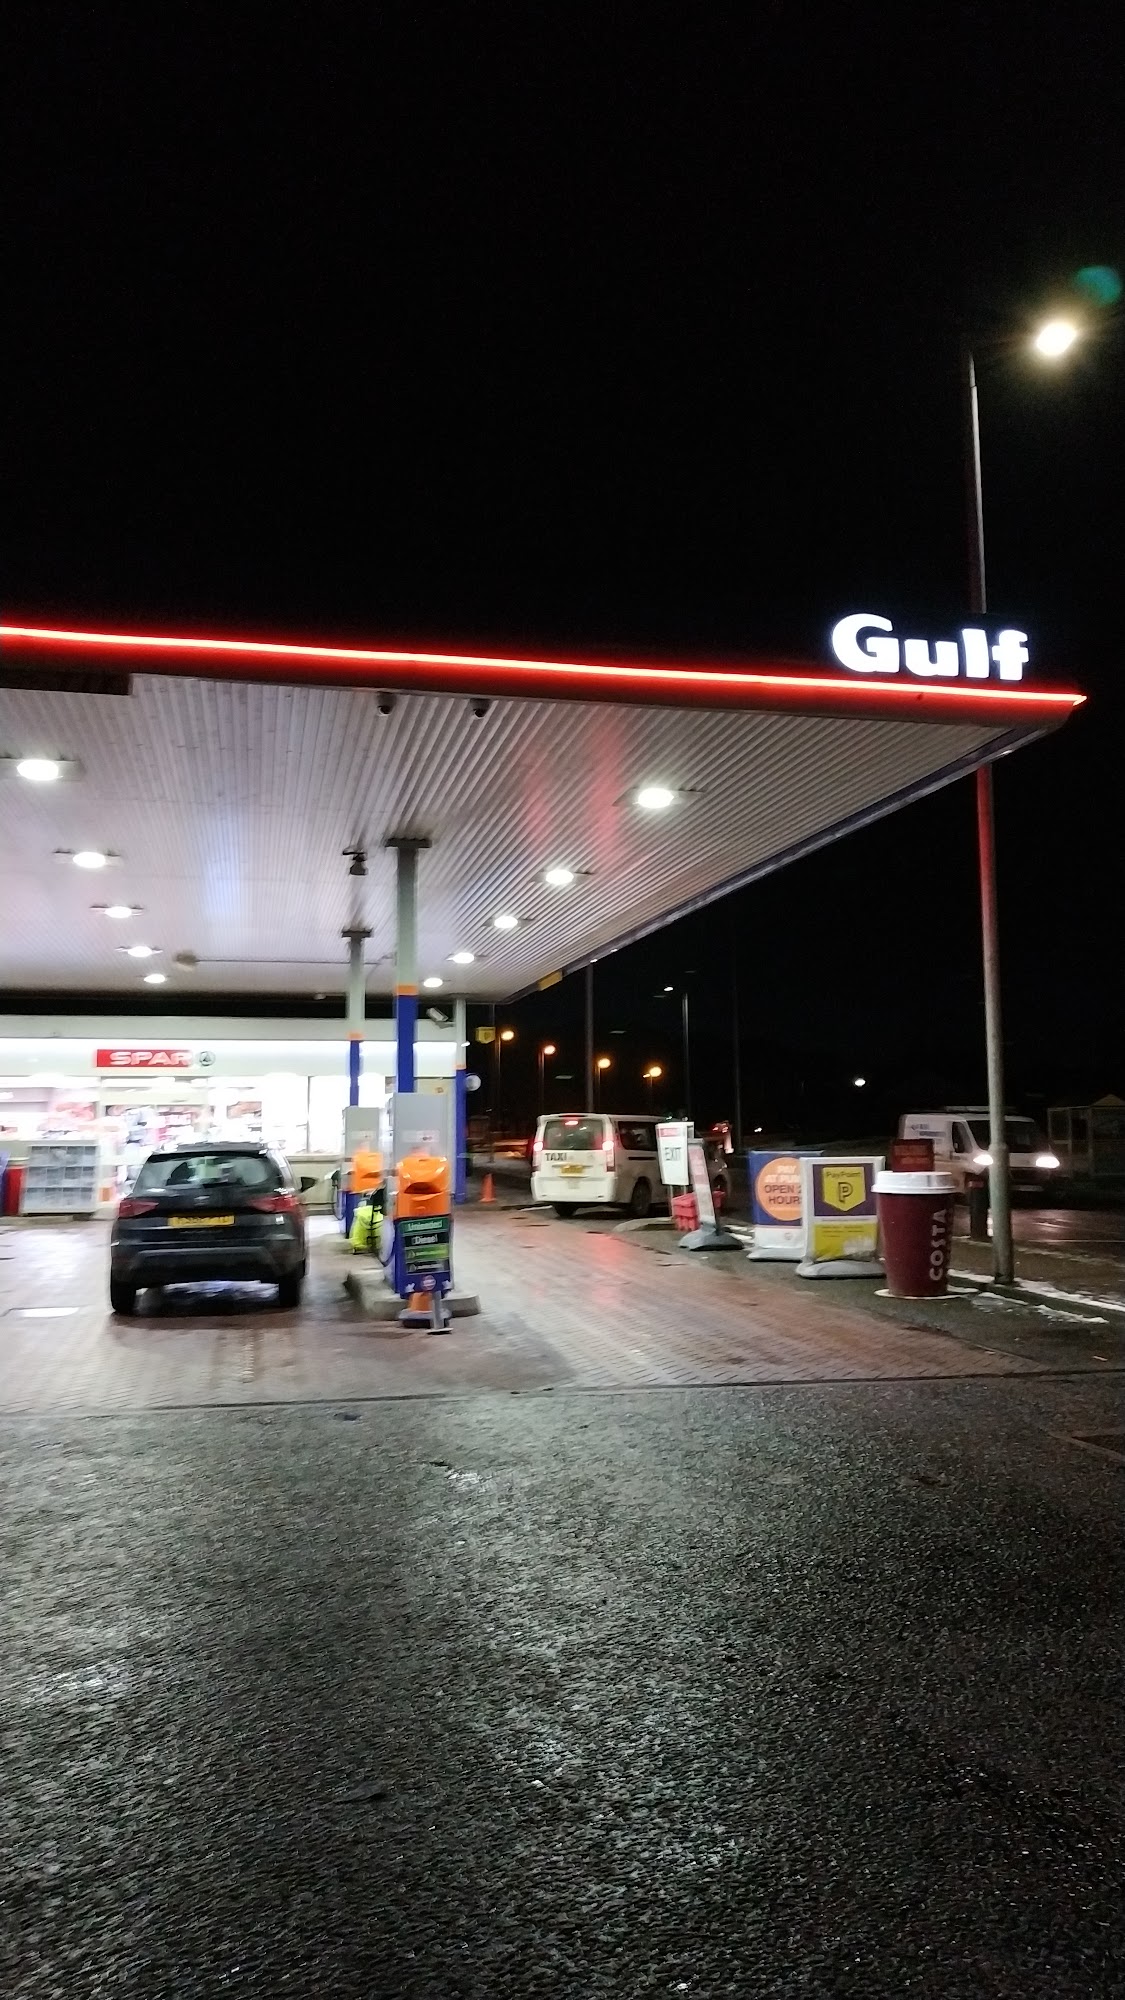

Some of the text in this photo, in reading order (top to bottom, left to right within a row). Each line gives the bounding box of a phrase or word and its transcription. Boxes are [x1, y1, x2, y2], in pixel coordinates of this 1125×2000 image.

[832, 613, 1029, 680] Gulf
[109, 1051, 192, 1065] SPAR
[545, 1152, 567, 1161] TAXI
[664, 1147, 681, 1160] EXIT
[764, 1184, 795, 1193] OPEN
[929, 1208, 948, 1281] COSTA
